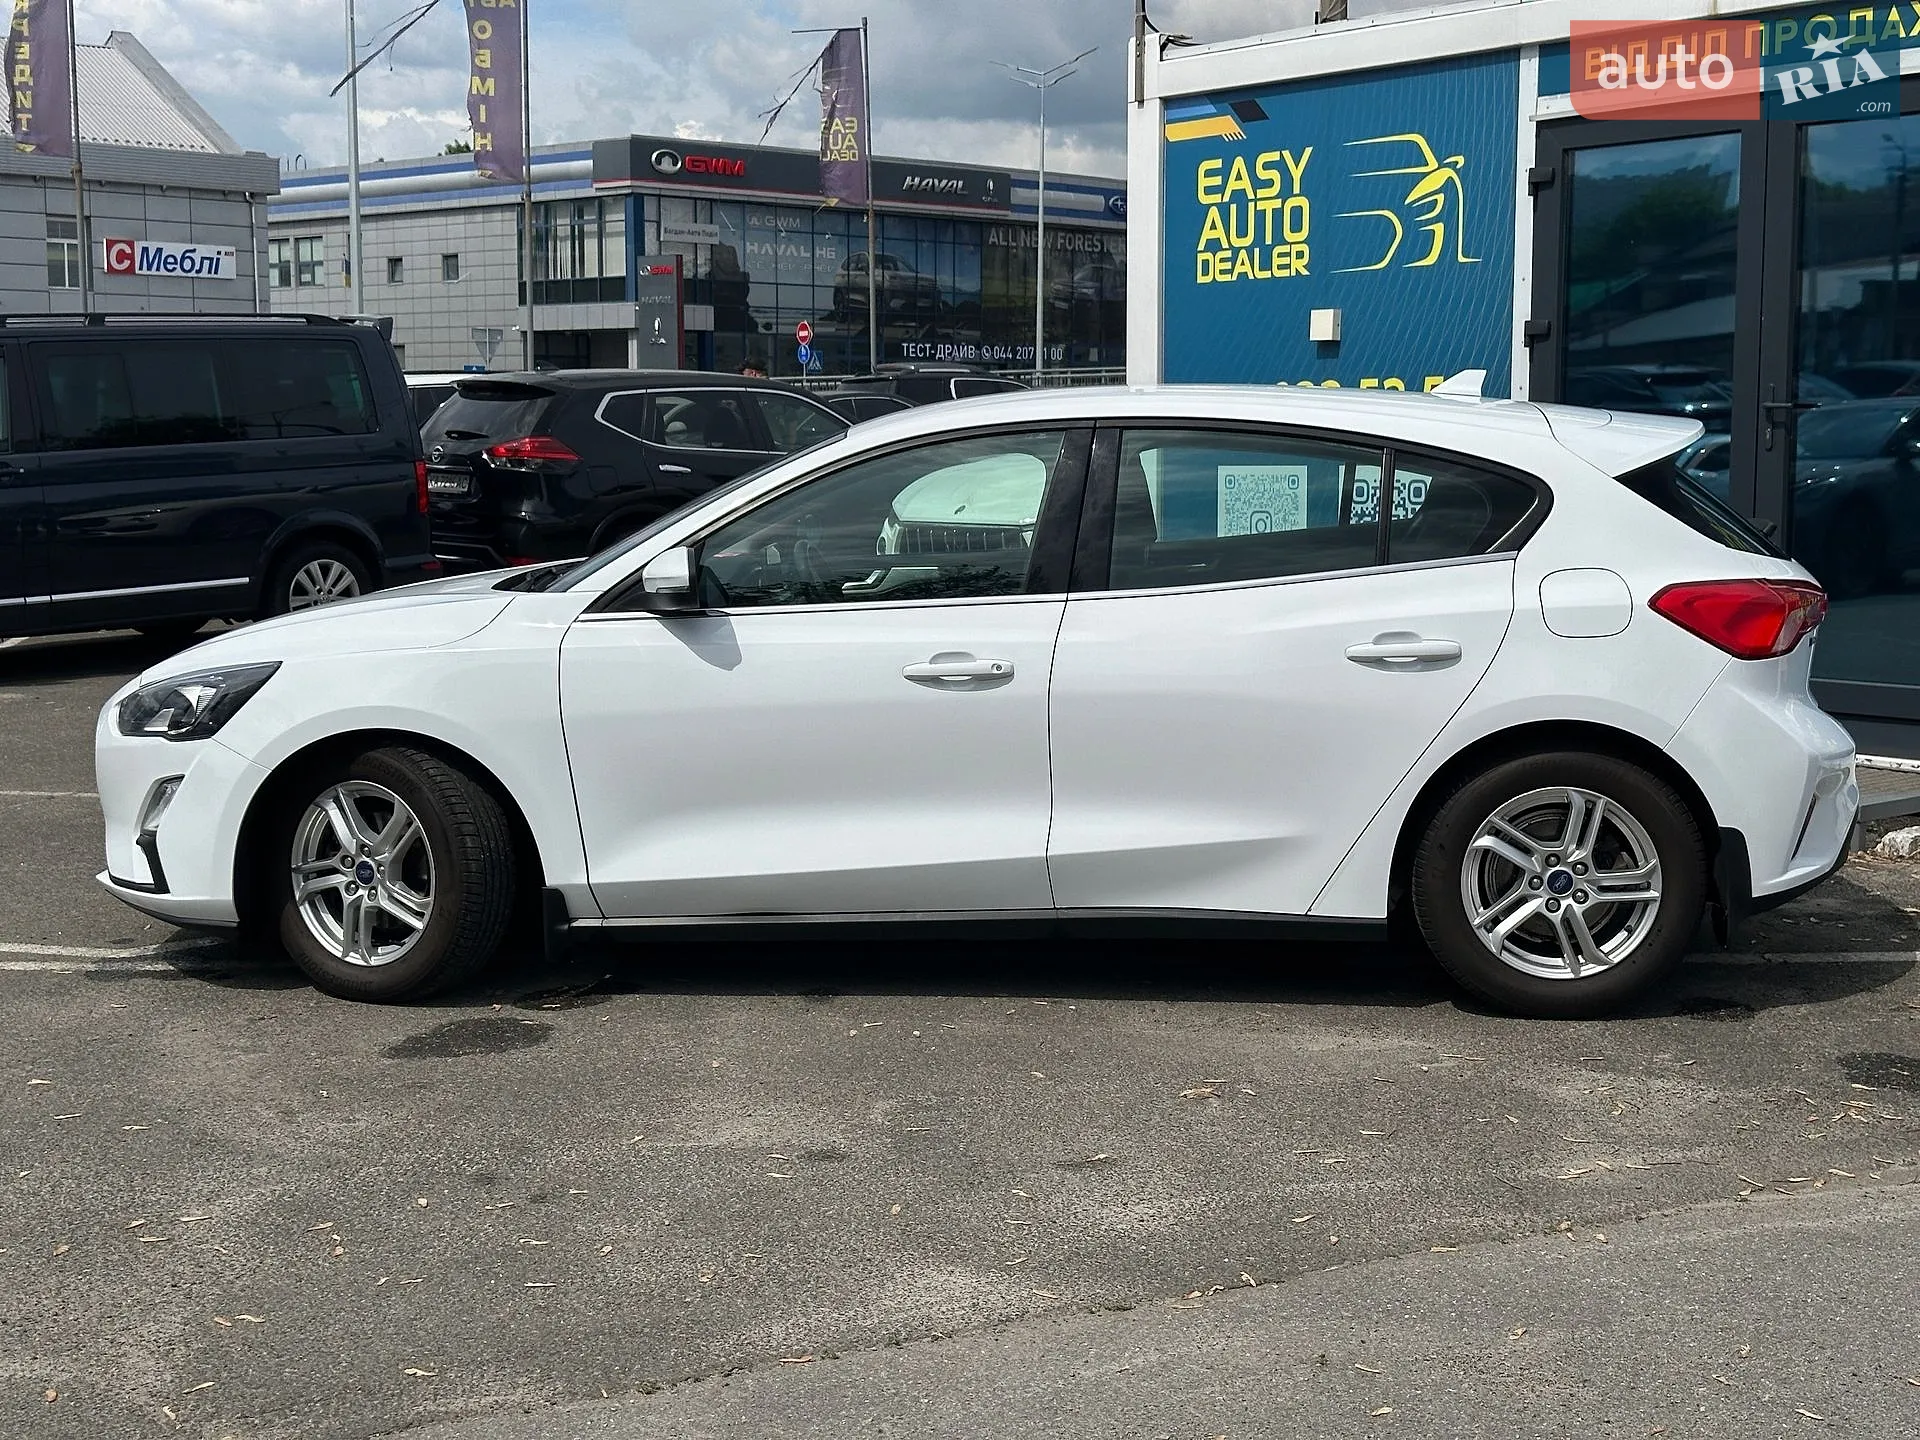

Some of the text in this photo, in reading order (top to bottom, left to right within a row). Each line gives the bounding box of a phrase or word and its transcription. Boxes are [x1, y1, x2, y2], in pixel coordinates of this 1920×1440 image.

[1584, 28, 1727, 81] ВІДДІЛ
[685, 156, 744, 176] GWM
[1197, 146, 1314, 205] EASY
[902, 176, 968, 194] HAVAL
[1197, 196, 1310, 251] AUTO
[745, 242, 811, 258] HAVAL
[988, 227, 1018, 247] ALL
[1020, 229, 1051, 249] NEW
[138, 246, 222, 275] Меблі
[1197, 243, 1311, 284] DEALER
[901, 343, 976, 360] ТЕСТ-ДРАЙВ
[993, 345, 1012, 359] 044
[1016, 346, 1034, 360] 207
[1050, 347, 1063, 361] 00
